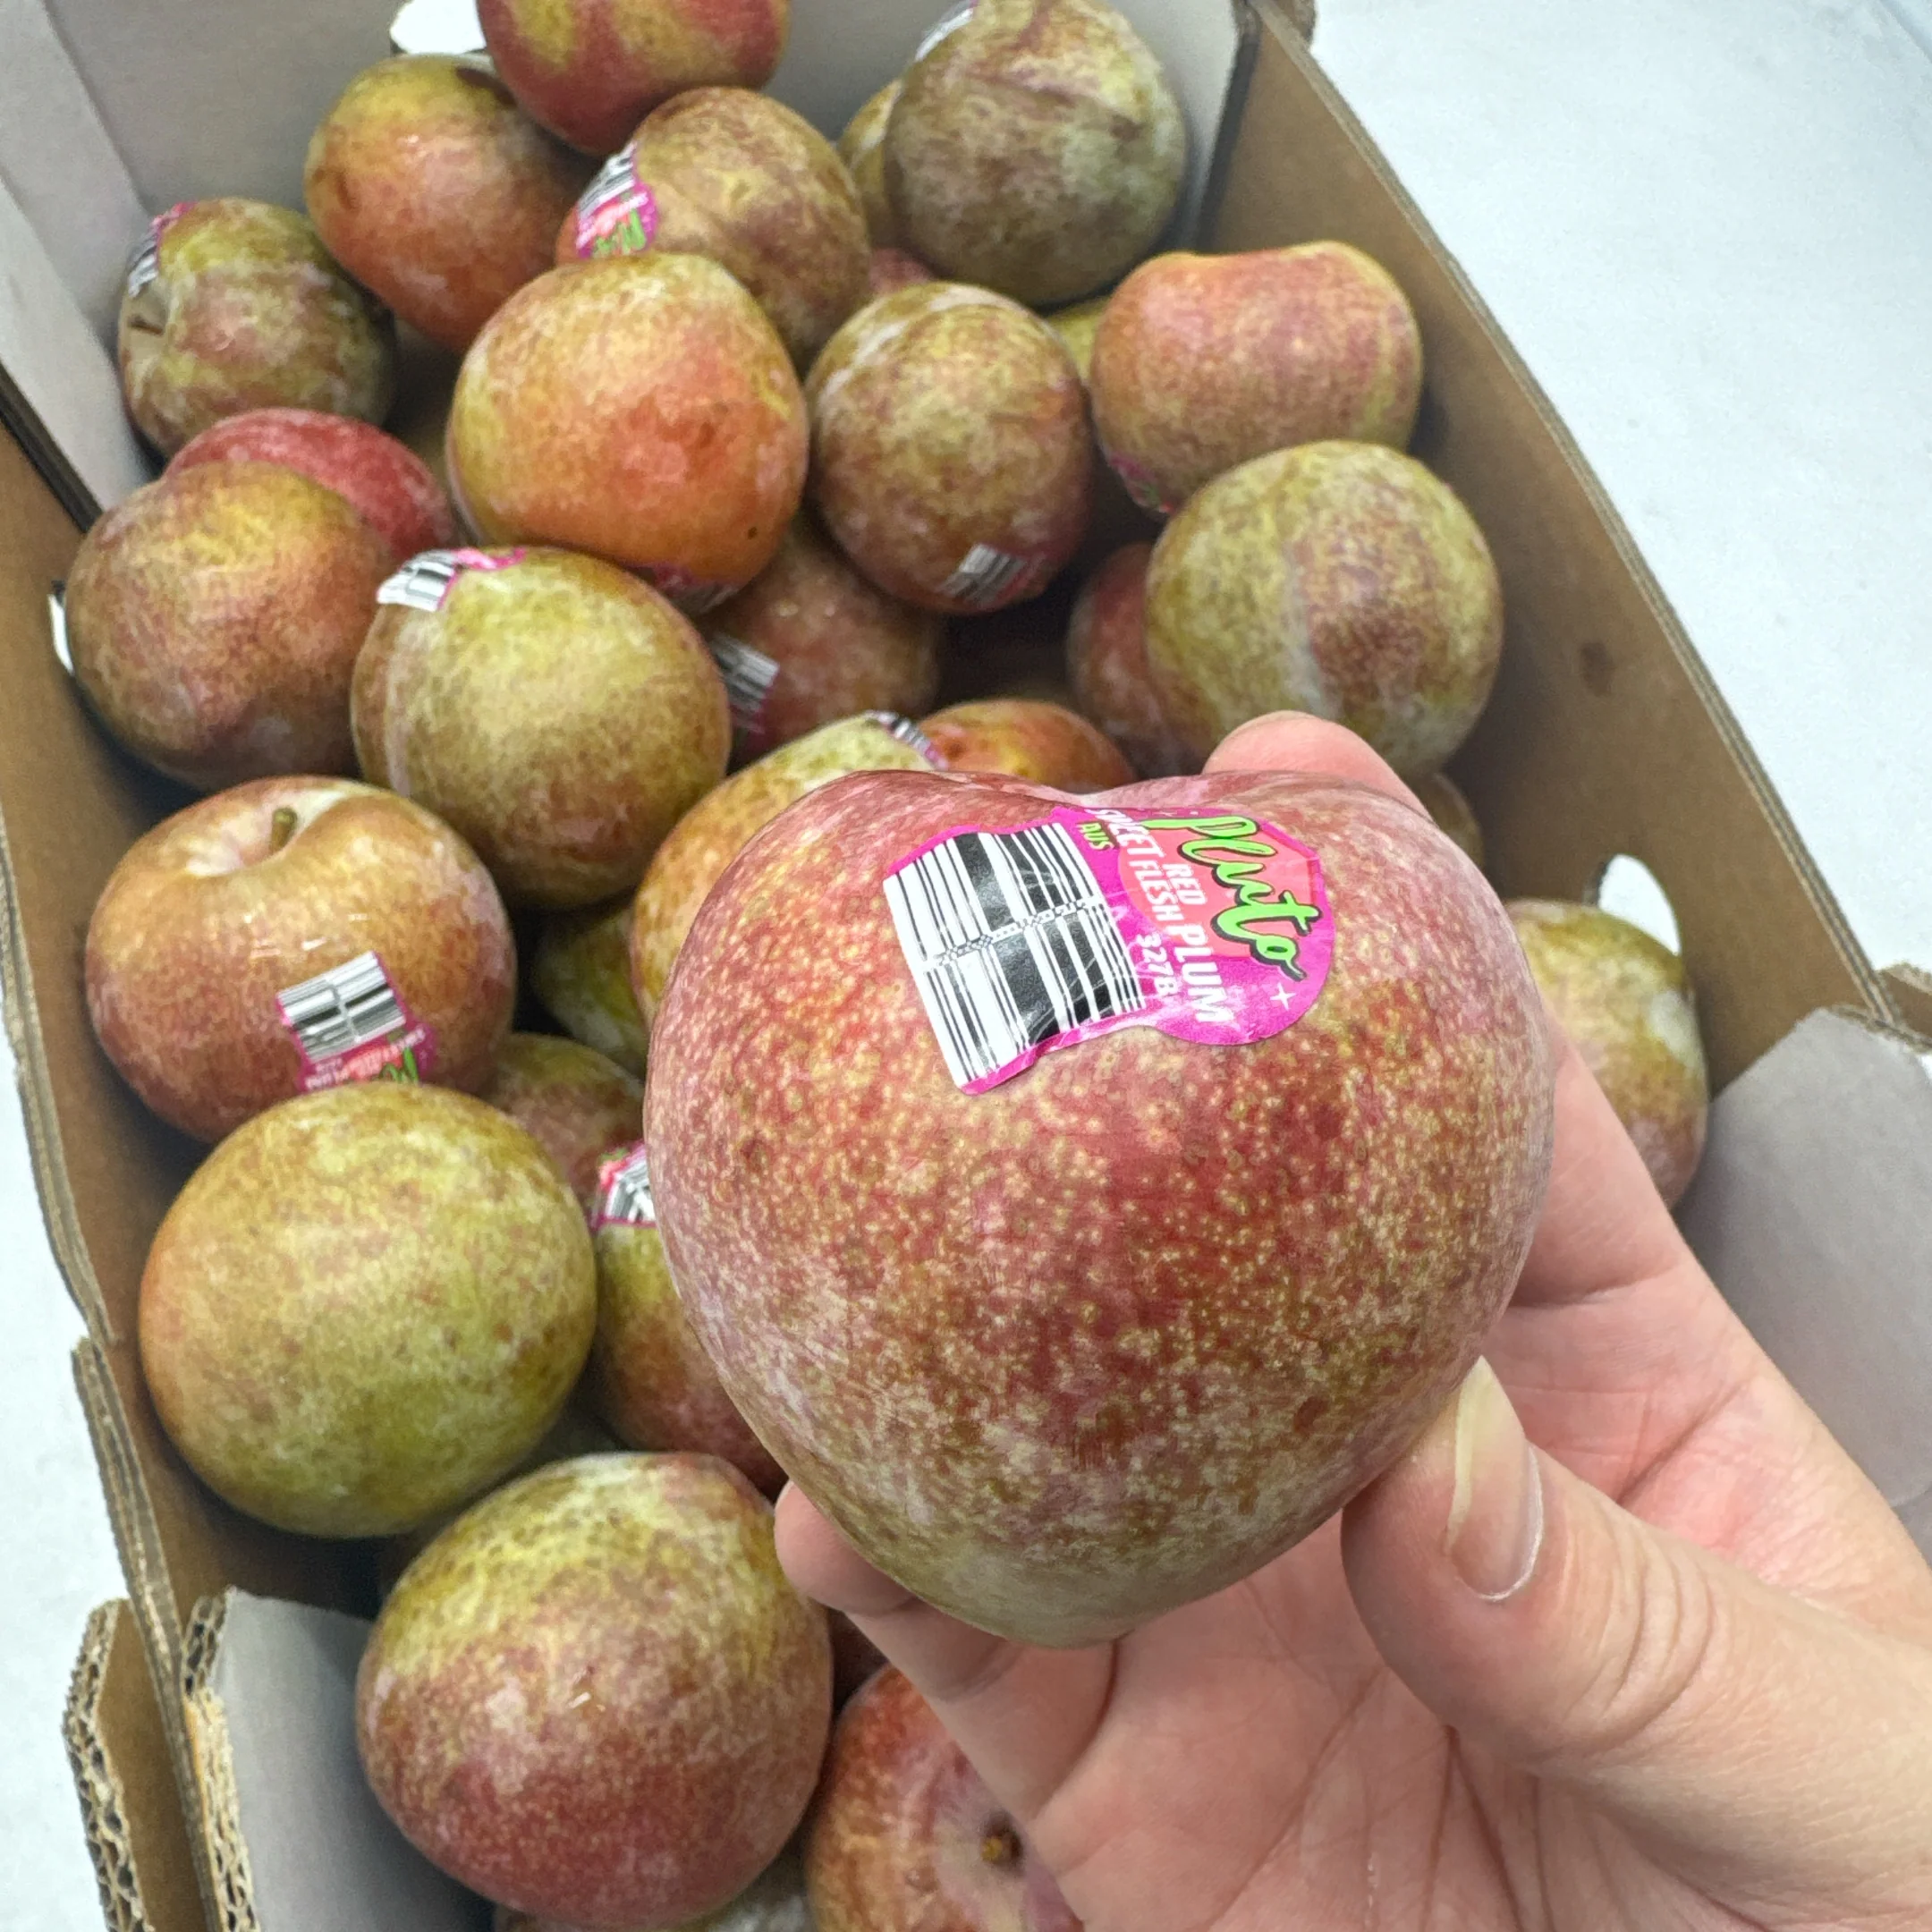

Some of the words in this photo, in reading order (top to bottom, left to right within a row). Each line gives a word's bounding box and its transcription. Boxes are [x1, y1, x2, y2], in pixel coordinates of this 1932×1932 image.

[1079, 821, 1114, 851] AUS
[1165, 861, 1208, 906] RED
[1128, 859, 1184, 922] FLESH
[1165, 923, 1233, 1022] PLUM
[1140, 815, 1322, 982] Pluto
